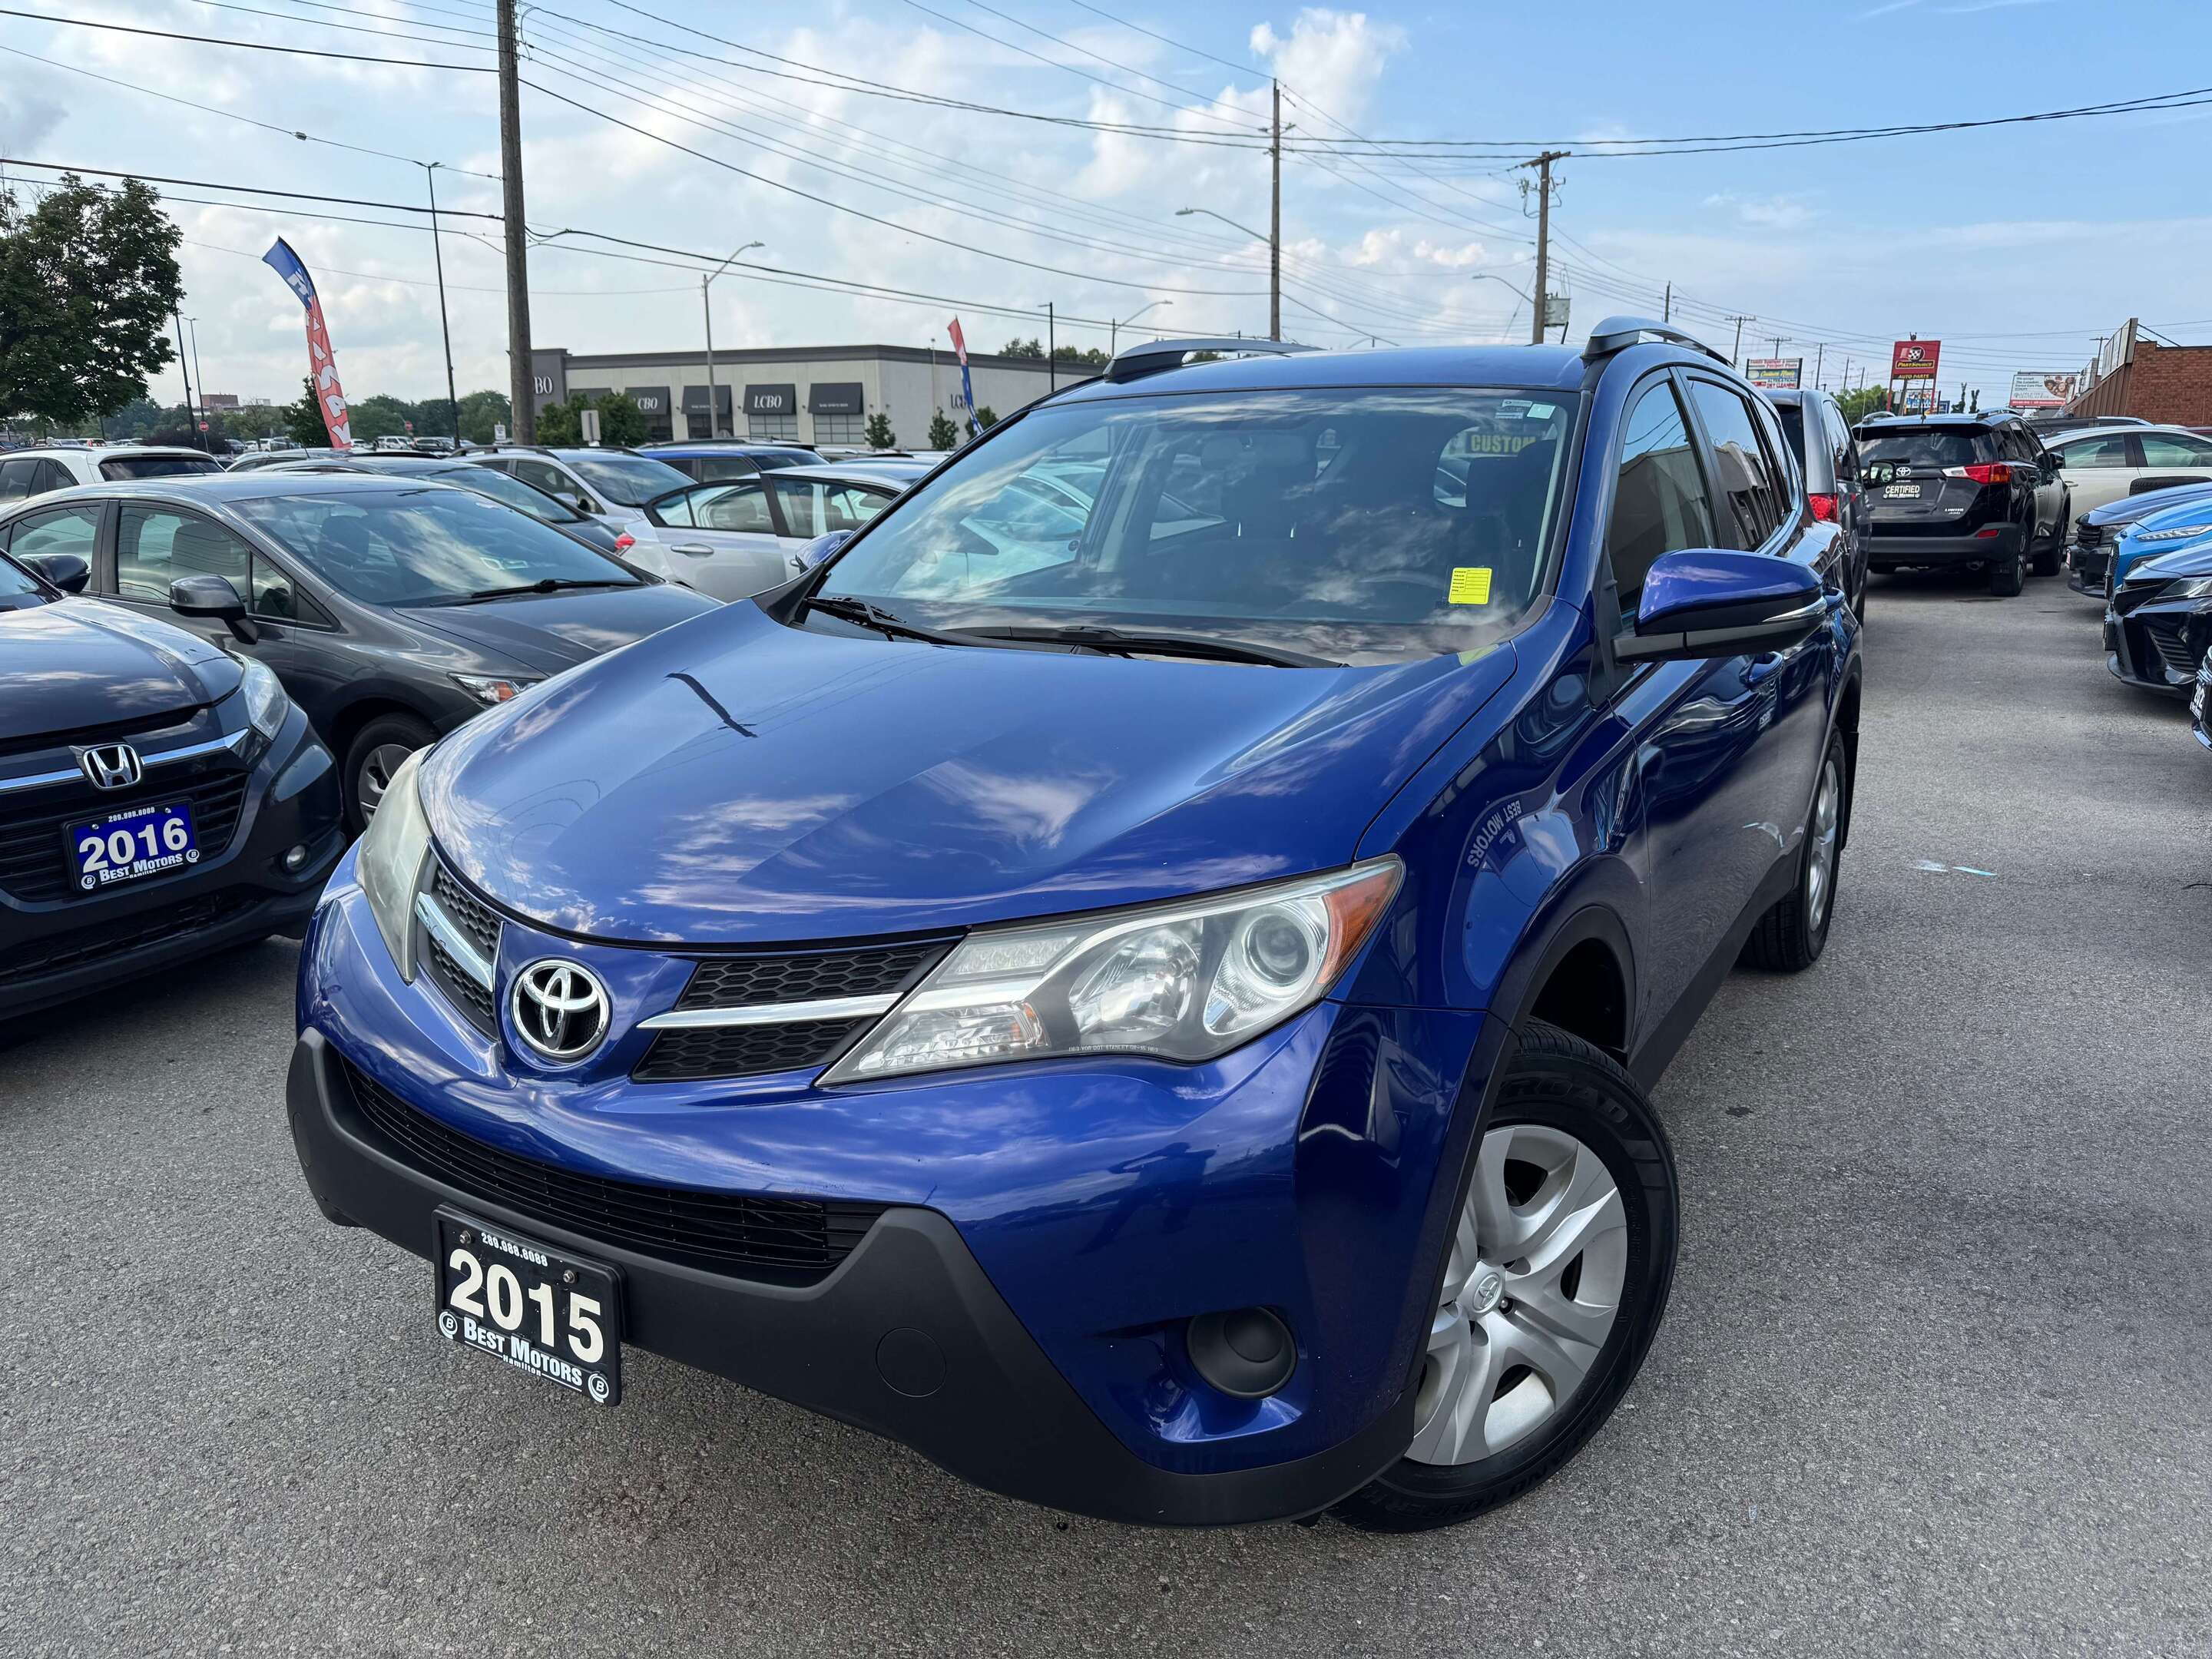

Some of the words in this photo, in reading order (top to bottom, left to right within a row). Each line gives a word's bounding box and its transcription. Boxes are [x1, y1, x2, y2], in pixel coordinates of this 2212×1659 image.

[534, 376, 553, 394] BO
[636, 397, 658, 410] CBO
[753, 395, 783, 409] LCBO
[1886, 485, 1920, 494] CERTIFIED
[1504, 800, 1522, 823] BEST
[79, 817, 188, 873] 2016
[1467, 812, 1505, 867] MOTORS
[129, 869, 157, 879] Hamilton
[481, 1232, 548, 1267] 289.988.8088
[449, 1248, 604, 1363] 2015
[502, 1354, 542, 1377] Hamilton
